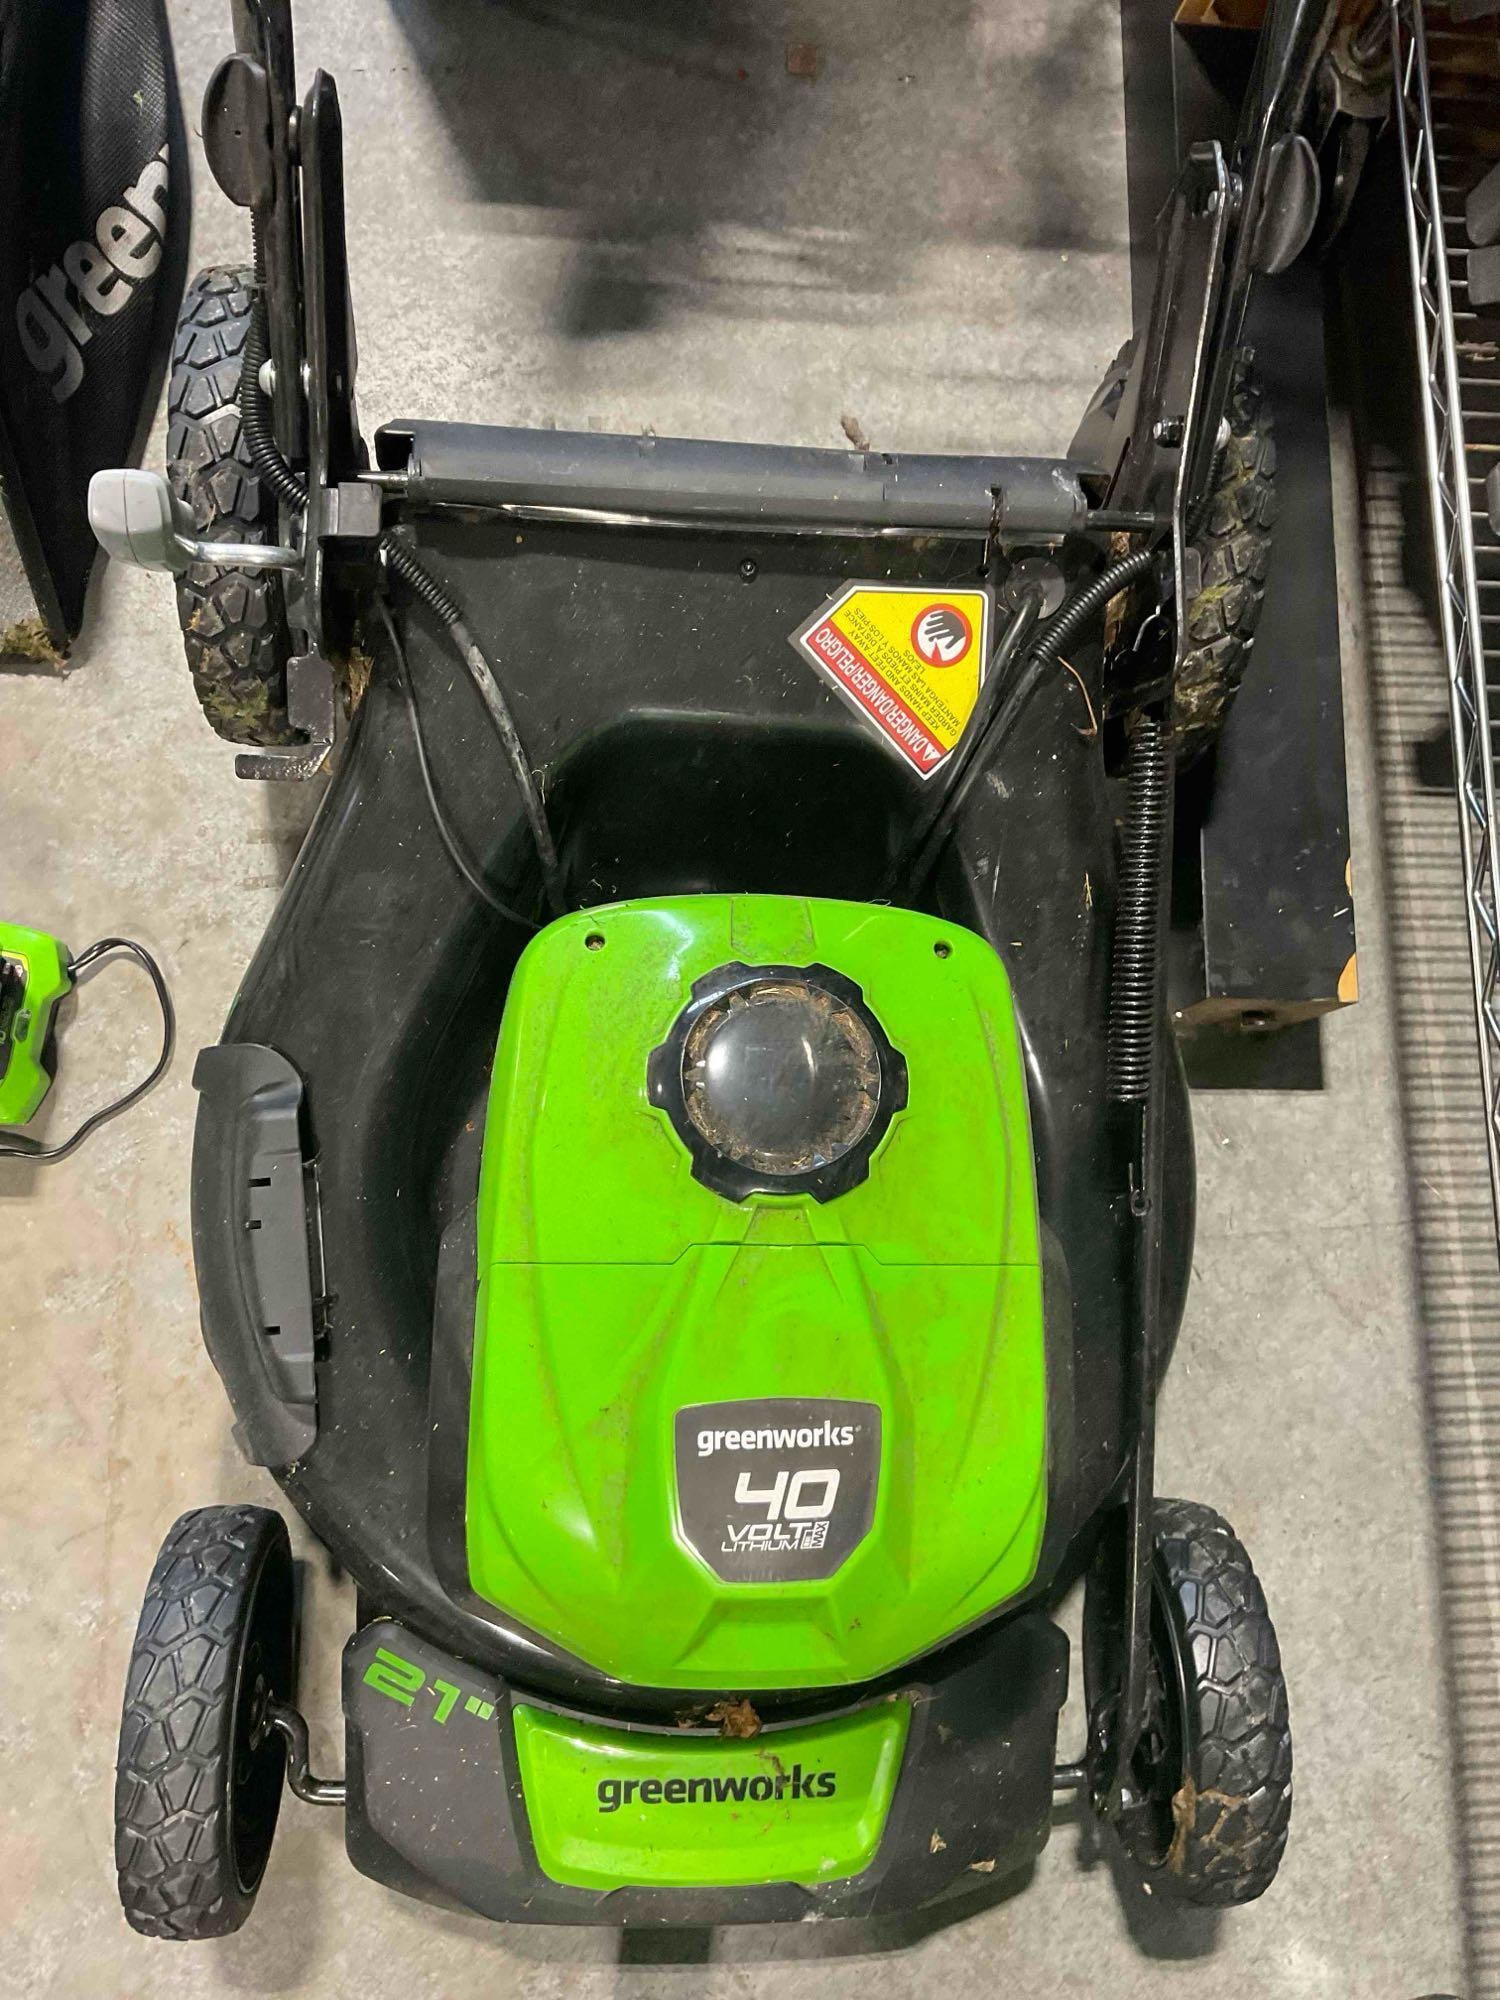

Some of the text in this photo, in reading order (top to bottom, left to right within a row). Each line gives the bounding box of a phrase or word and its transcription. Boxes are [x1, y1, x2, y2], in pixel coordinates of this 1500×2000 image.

[16, 143, 169, 403] green
[842, 608, 877, 646] DISTANCE
[852, 606, 871, 626] PIES
[868, 623, 884, 641] LOS
[880, 651, 902, 674] PIEDS
[887, 645, 913, 673] MANOS
[901, 648, 926, 674] LEJOS
[813, 625, 929, 753] DANGER/DANGER/PELIGRO
[848, 628, 940, 730] KEEP HANDS AND FEET AWAY
[900, 673, 912, 685] ET
[910, 671, 926, 688] LAS
[908, 682, 931, 707] MAINS
[923, 686, 961, 727] MANTENGA
[928, 705, 958, 736] GARDER
[697, 1420, 854, 1456] greenworks
[735, 1468, 840, 1520] 40
[727, 1522, 812, 1542] VOLT
[812, 1523, 828, 1547] MAX
[721, 1540, 799, 1552] LITHIUM
[598, 1764, 836, 1812] greenworks
